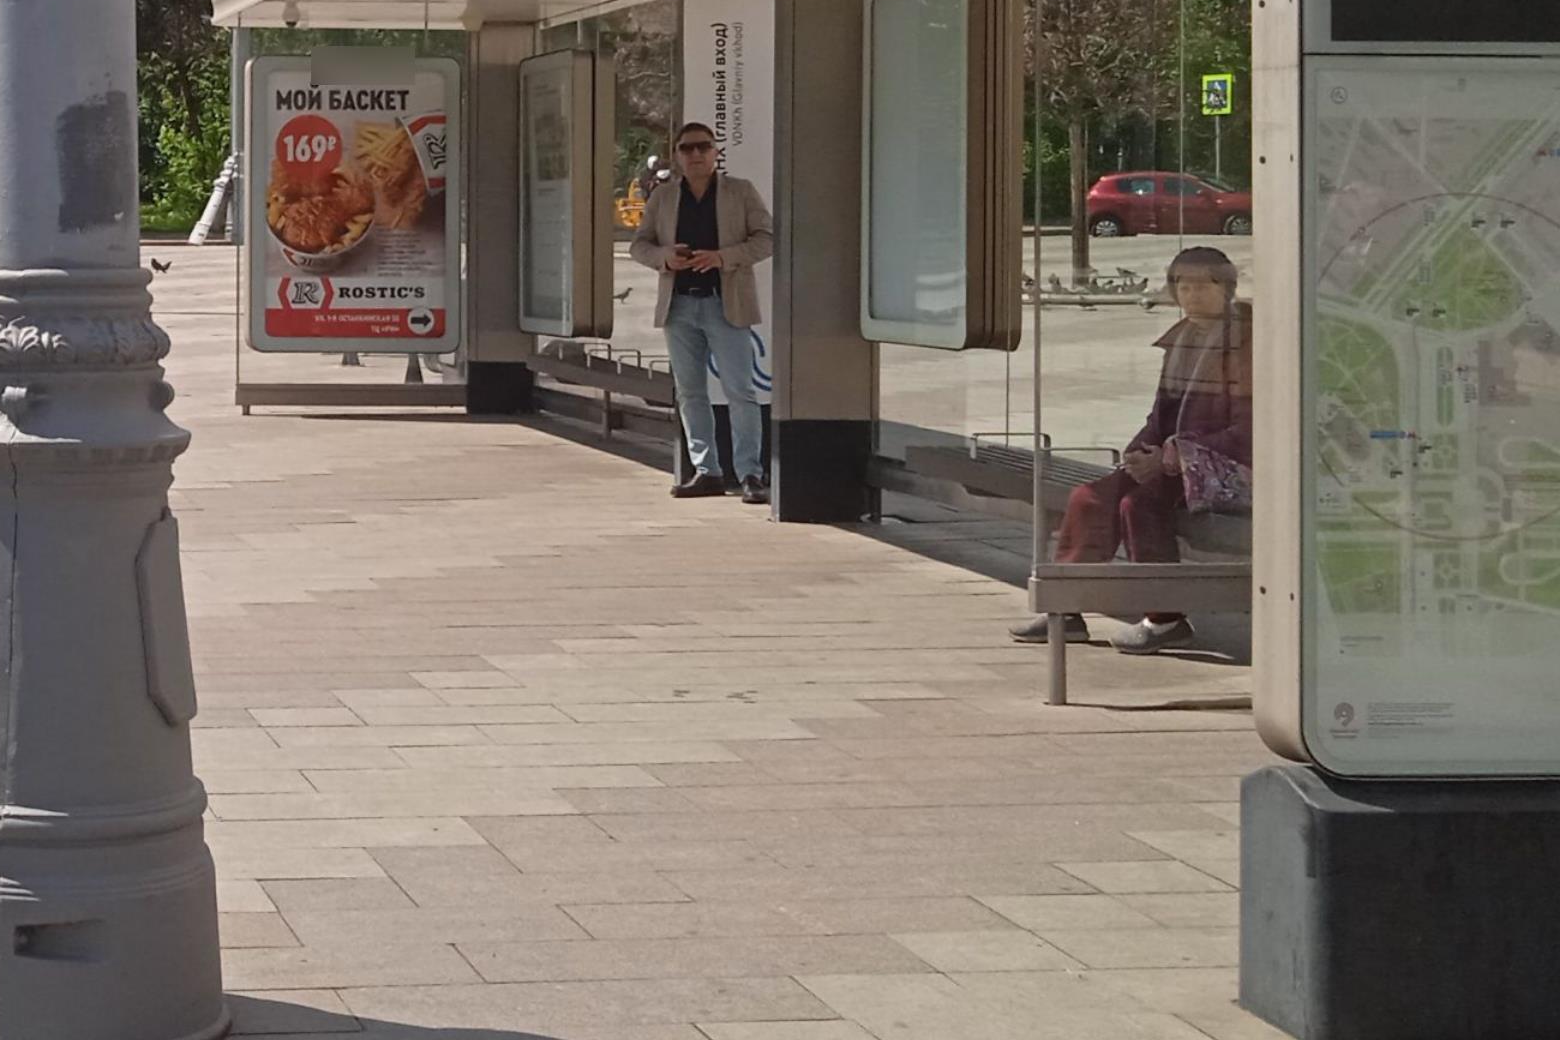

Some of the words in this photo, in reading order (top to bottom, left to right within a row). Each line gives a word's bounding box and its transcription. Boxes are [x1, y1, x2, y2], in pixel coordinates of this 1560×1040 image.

[710, 22, 729, 65] вход)
[276, 85, 322, 111] МОЙ
[328, 90, 410, 111] БАСКЕТ
[711, 70, 729, 143] (главный
[715, 146, 729, 175] НХ
[338, 286, 426, 299] ROSTIC'S
